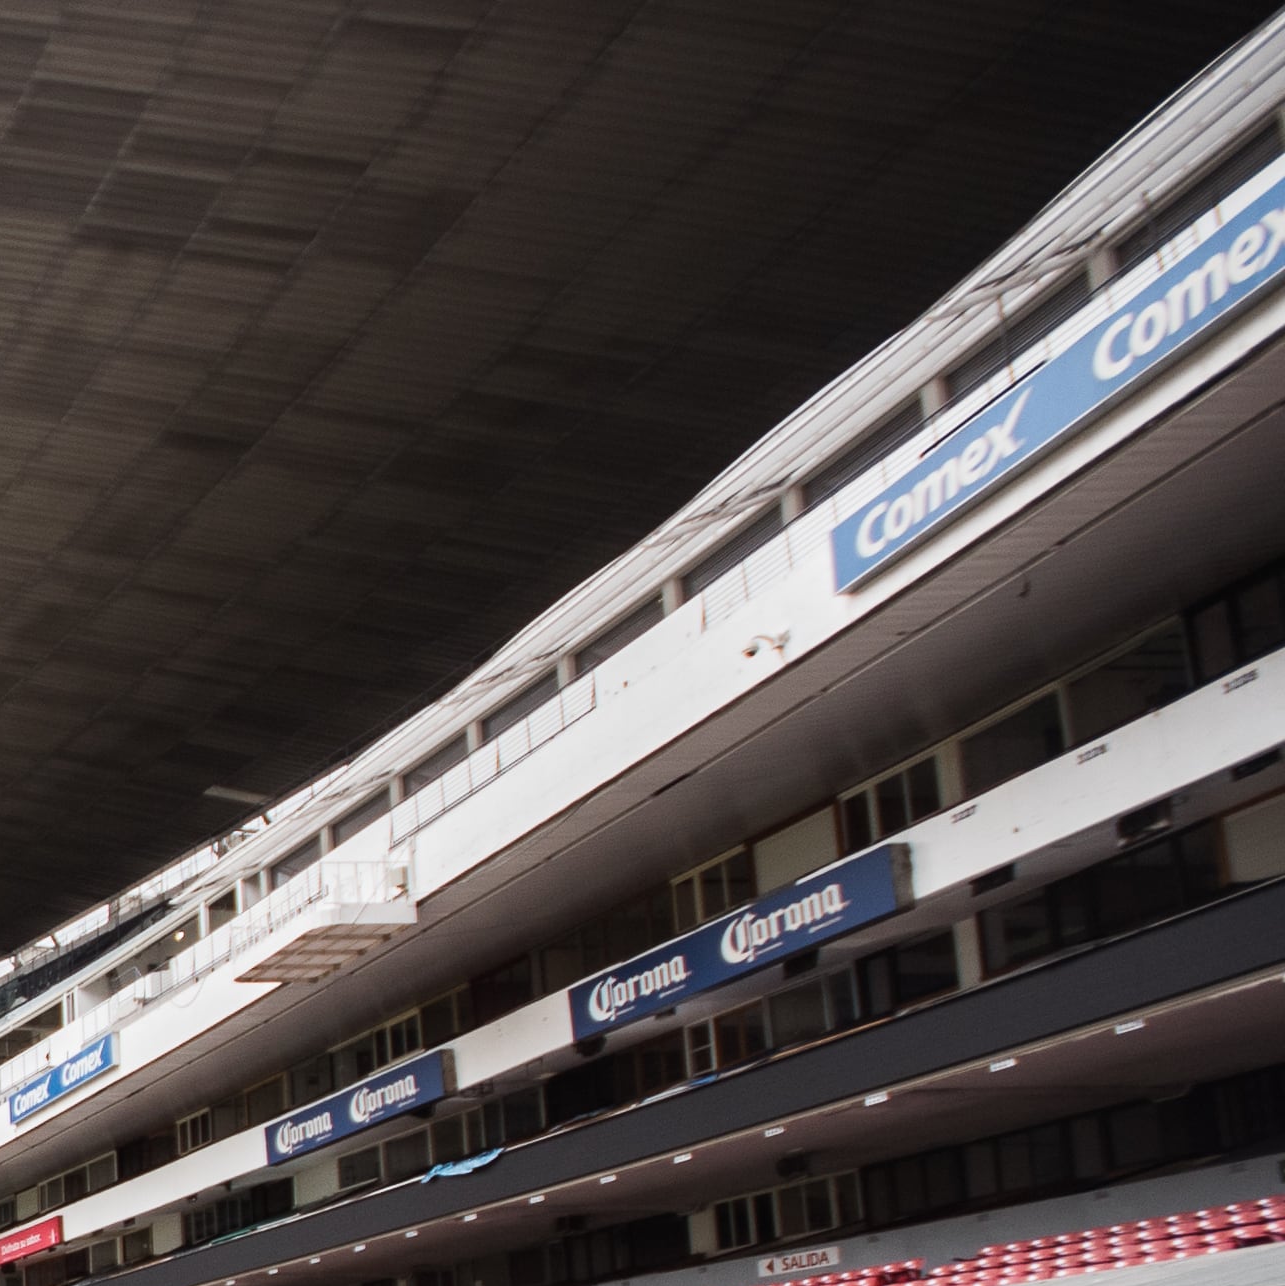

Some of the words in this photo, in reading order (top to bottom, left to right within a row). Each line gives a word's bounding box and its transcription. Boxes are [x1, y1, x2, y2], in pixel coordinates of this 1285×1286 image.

[856, 386, 1033, 558] Comex
[588, 955, 692, 1022] Corona
[720, 883, 851, 963] Corona
[14, 1073, 51, 1116] Comex
[61, 1039, 105, 1088] Comex
[276, 1112, 333, 1153] Corona
[349, 1074, 420, 1122] Corona
[782, 1251, 829, 1271] SALIDA
